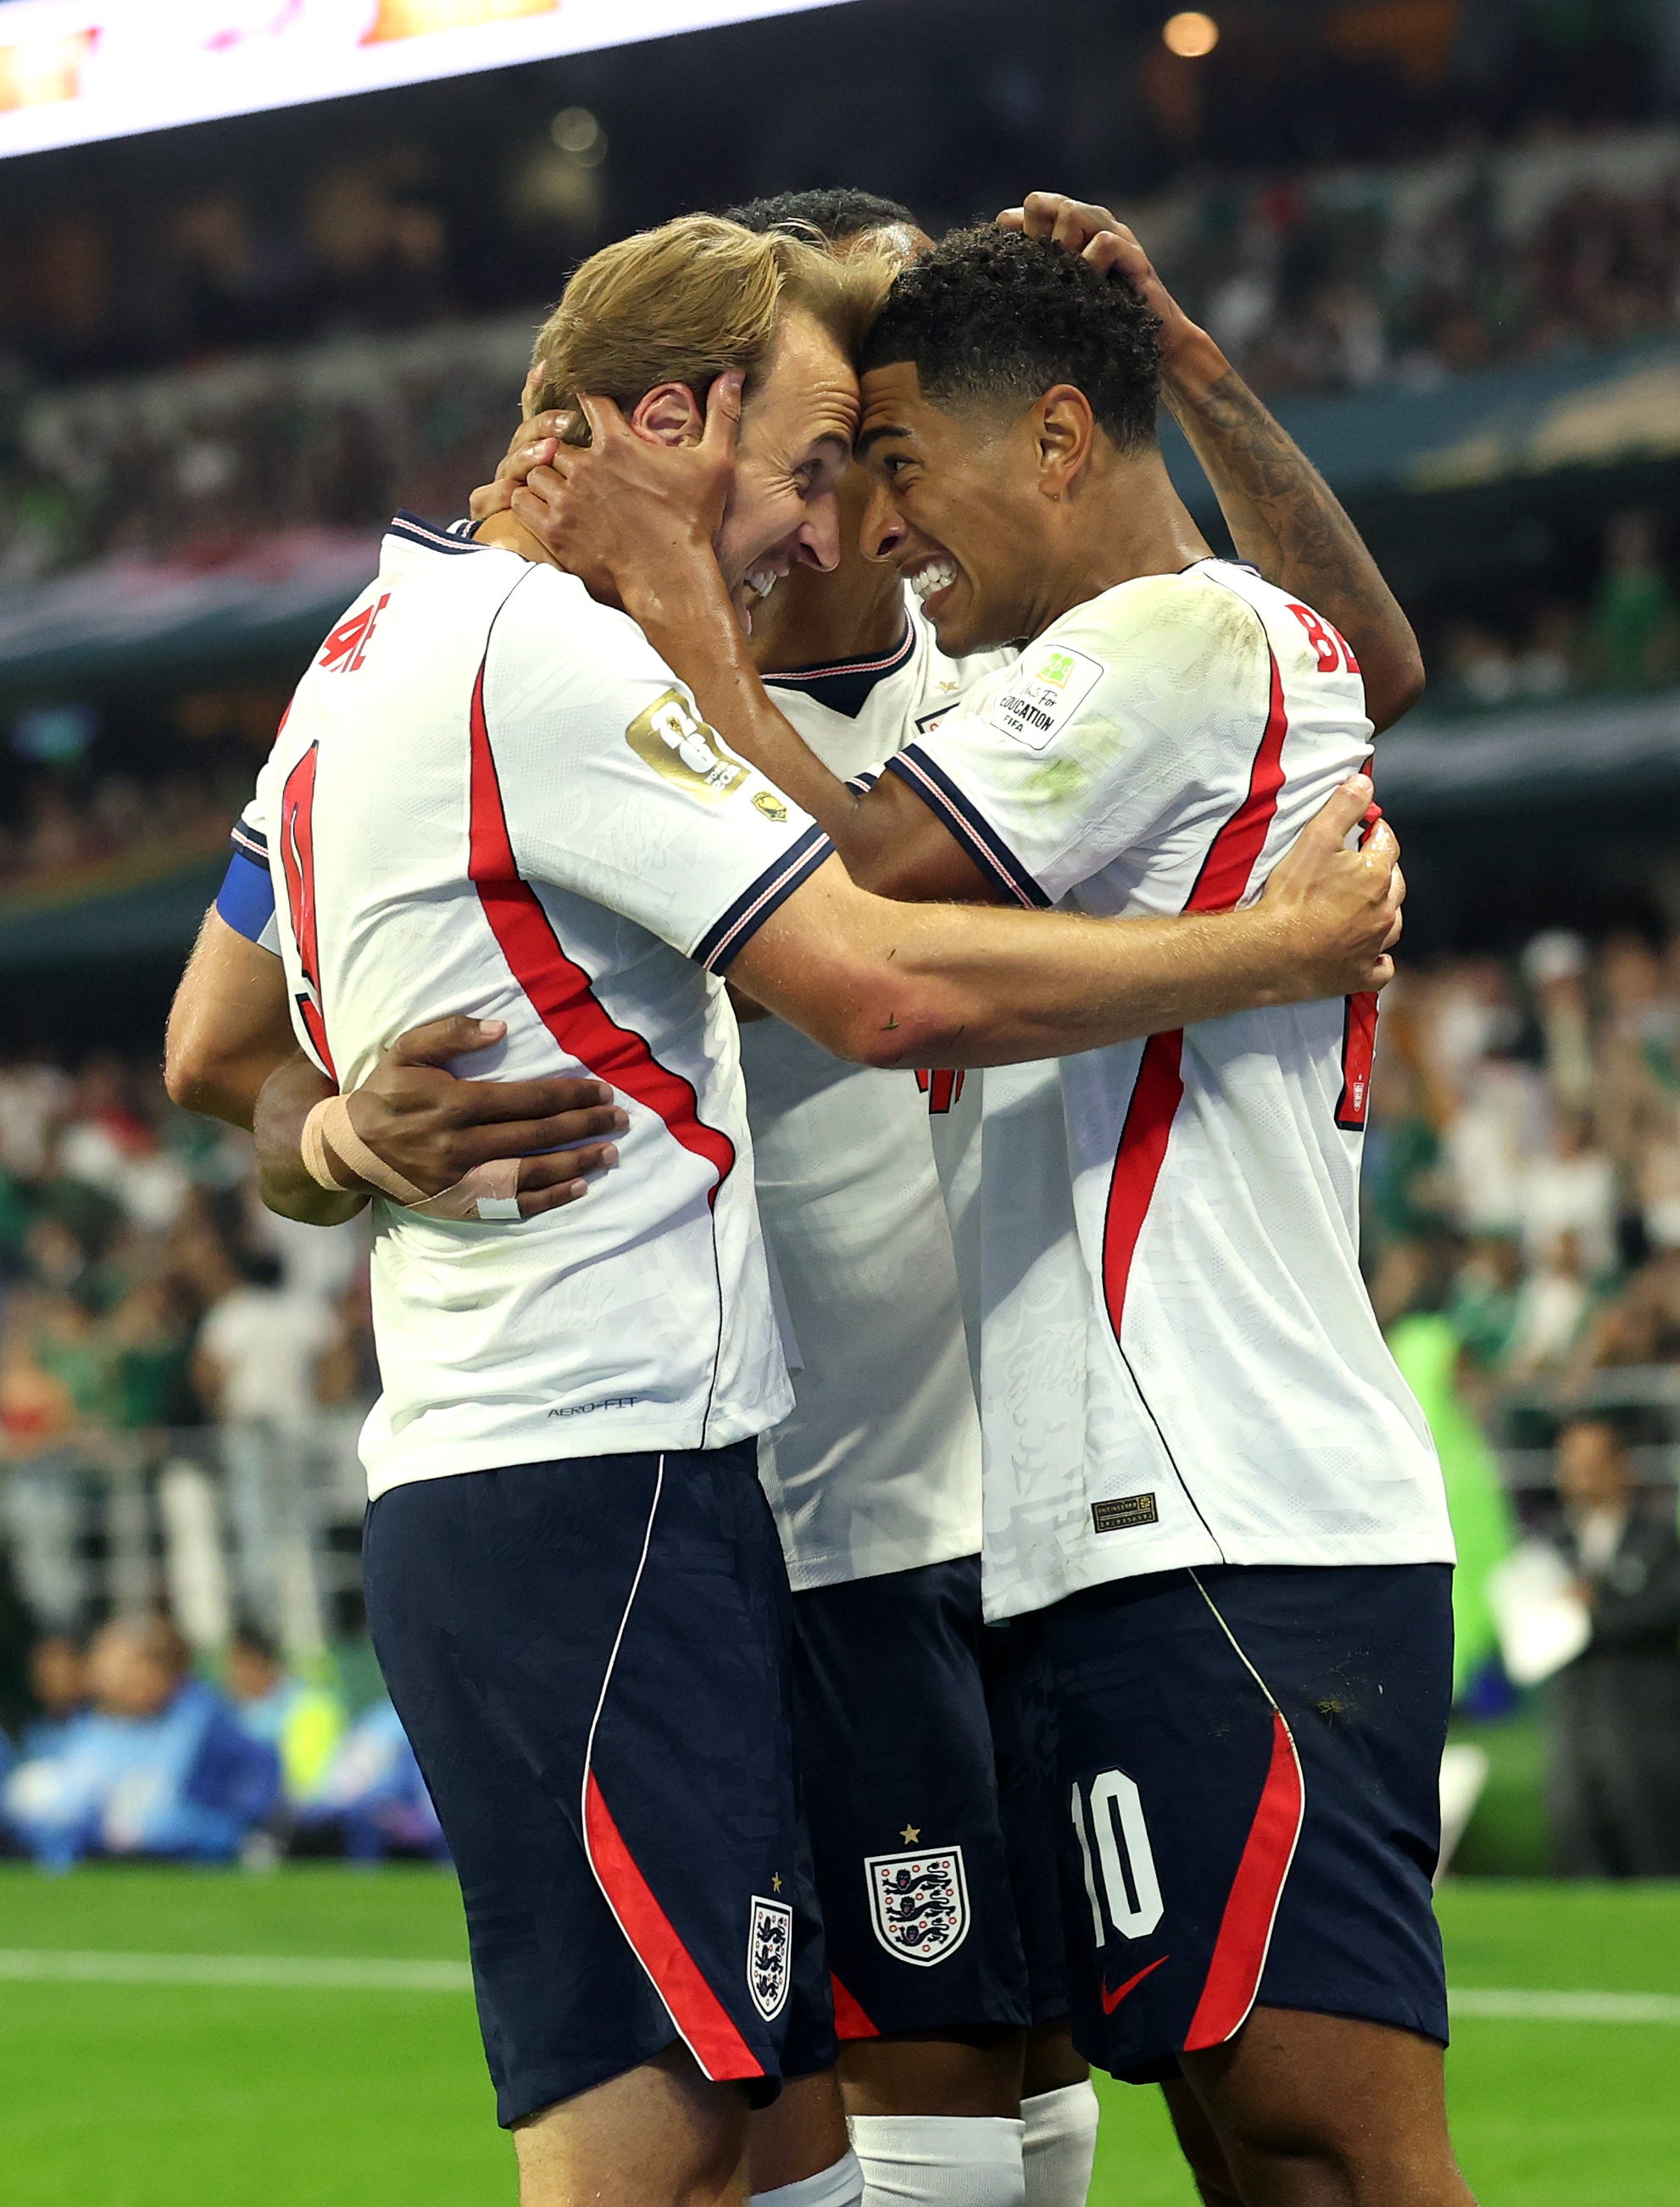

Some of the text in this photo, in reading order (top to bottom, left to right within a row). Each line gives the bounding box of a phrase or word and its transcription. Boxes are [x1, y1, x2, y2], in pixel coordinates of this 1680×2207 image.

[1037, 689, 1058, 707] For
[999, 695, 1054, 732] EDUCATION
[1003, 715, 1023, 733] FIFA
[548, 1396, 637, 1418] AERO-FIT
[1071, 1769, 1165, 1948] 10
